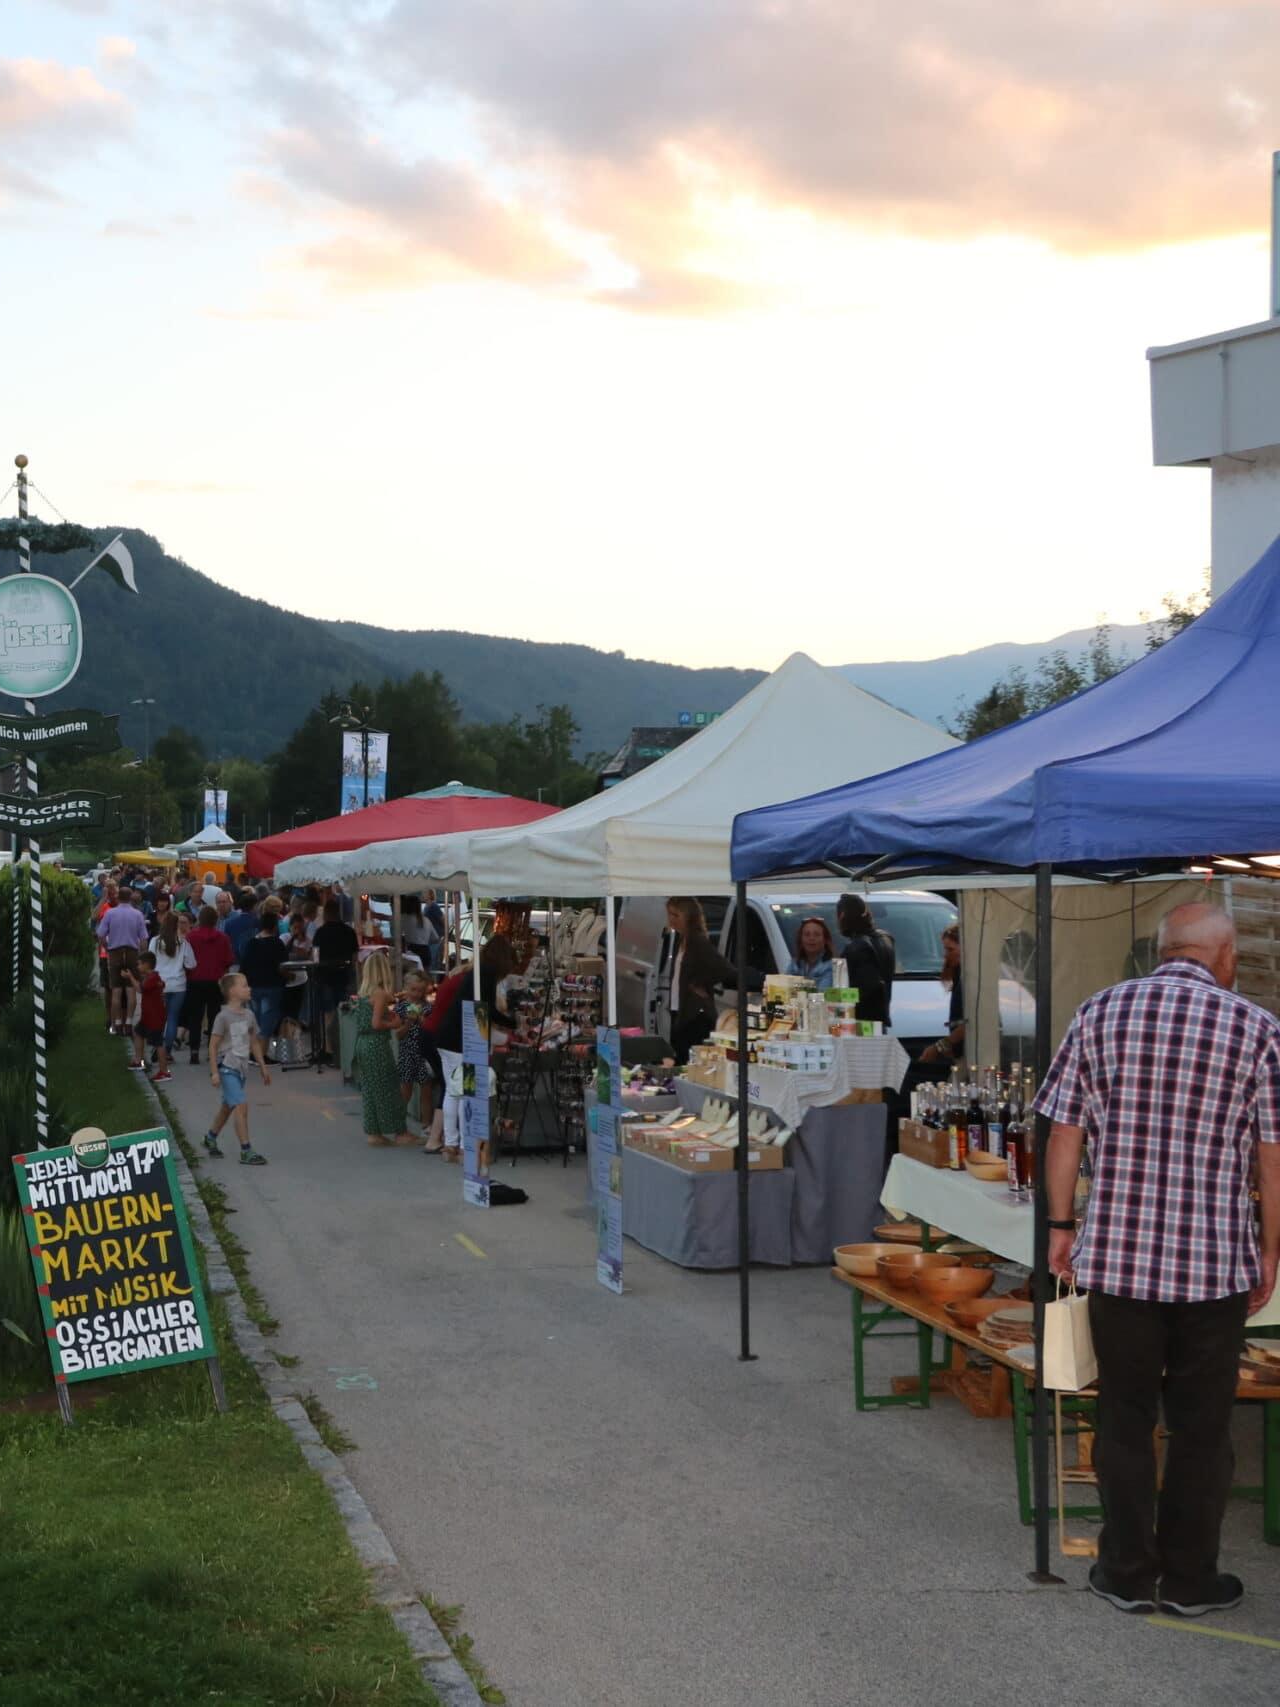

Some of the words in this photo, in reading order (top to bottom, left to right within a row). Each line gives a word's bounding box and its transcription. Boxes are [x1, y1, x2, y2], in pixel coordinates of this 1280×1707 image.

[23, 721, 88, 741] willkommen
[74, 1142, 107, 1156] Gösser
[24, 1155, 78, 1182] JEDEN
[105, 1151, 127, 1168] AB
[32, 1192, 173, 1245] BAUERN-
[40, 1230, 173, 1284] MARKT
